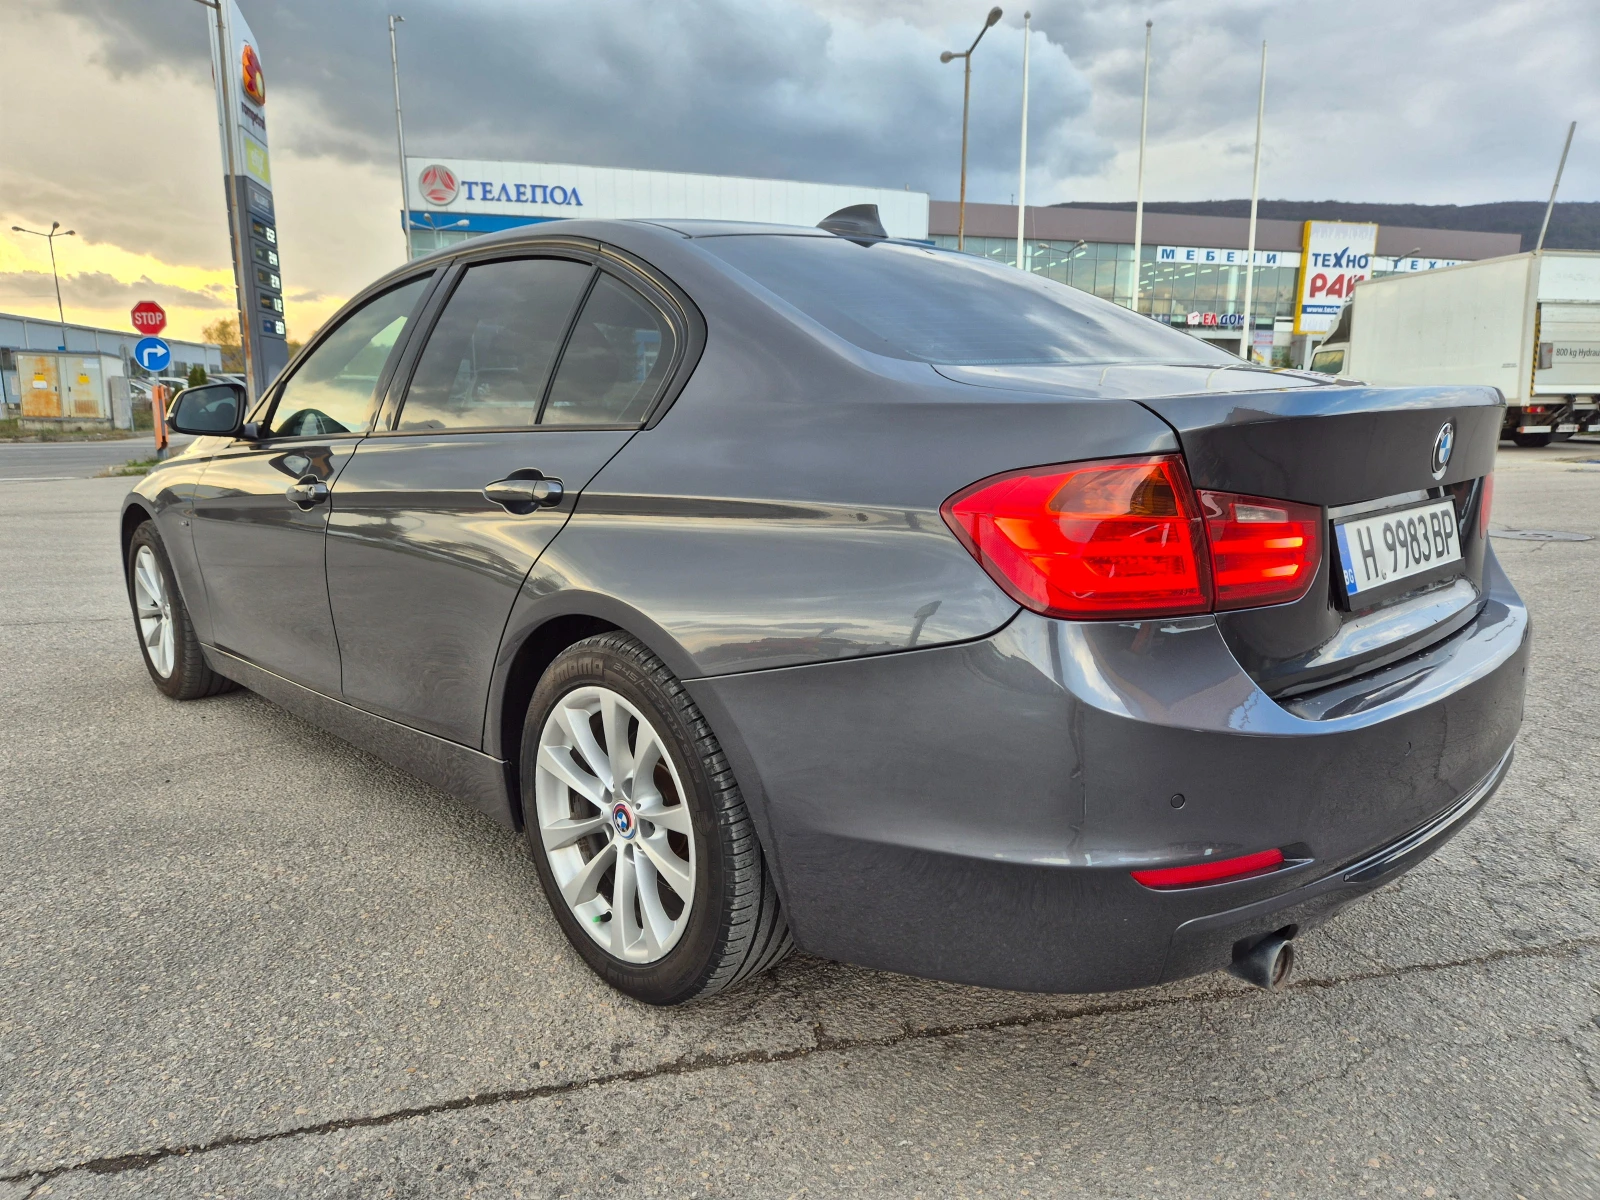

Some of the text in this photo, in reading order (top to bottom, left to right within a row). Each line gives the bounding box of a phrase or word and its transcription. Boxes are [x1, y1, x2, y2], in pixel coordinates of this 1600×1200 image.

[461, 181, 583, 206] ТЕЛЕПОЛ
[1312, 246, 1369, 269] ТЕХНО
[134, 311, 163, 325] STOP
[1556, 348, 1568, 356] 800
[1569, 348, 1577, 359] kg
[1344, 569, 1355, 586] BG
